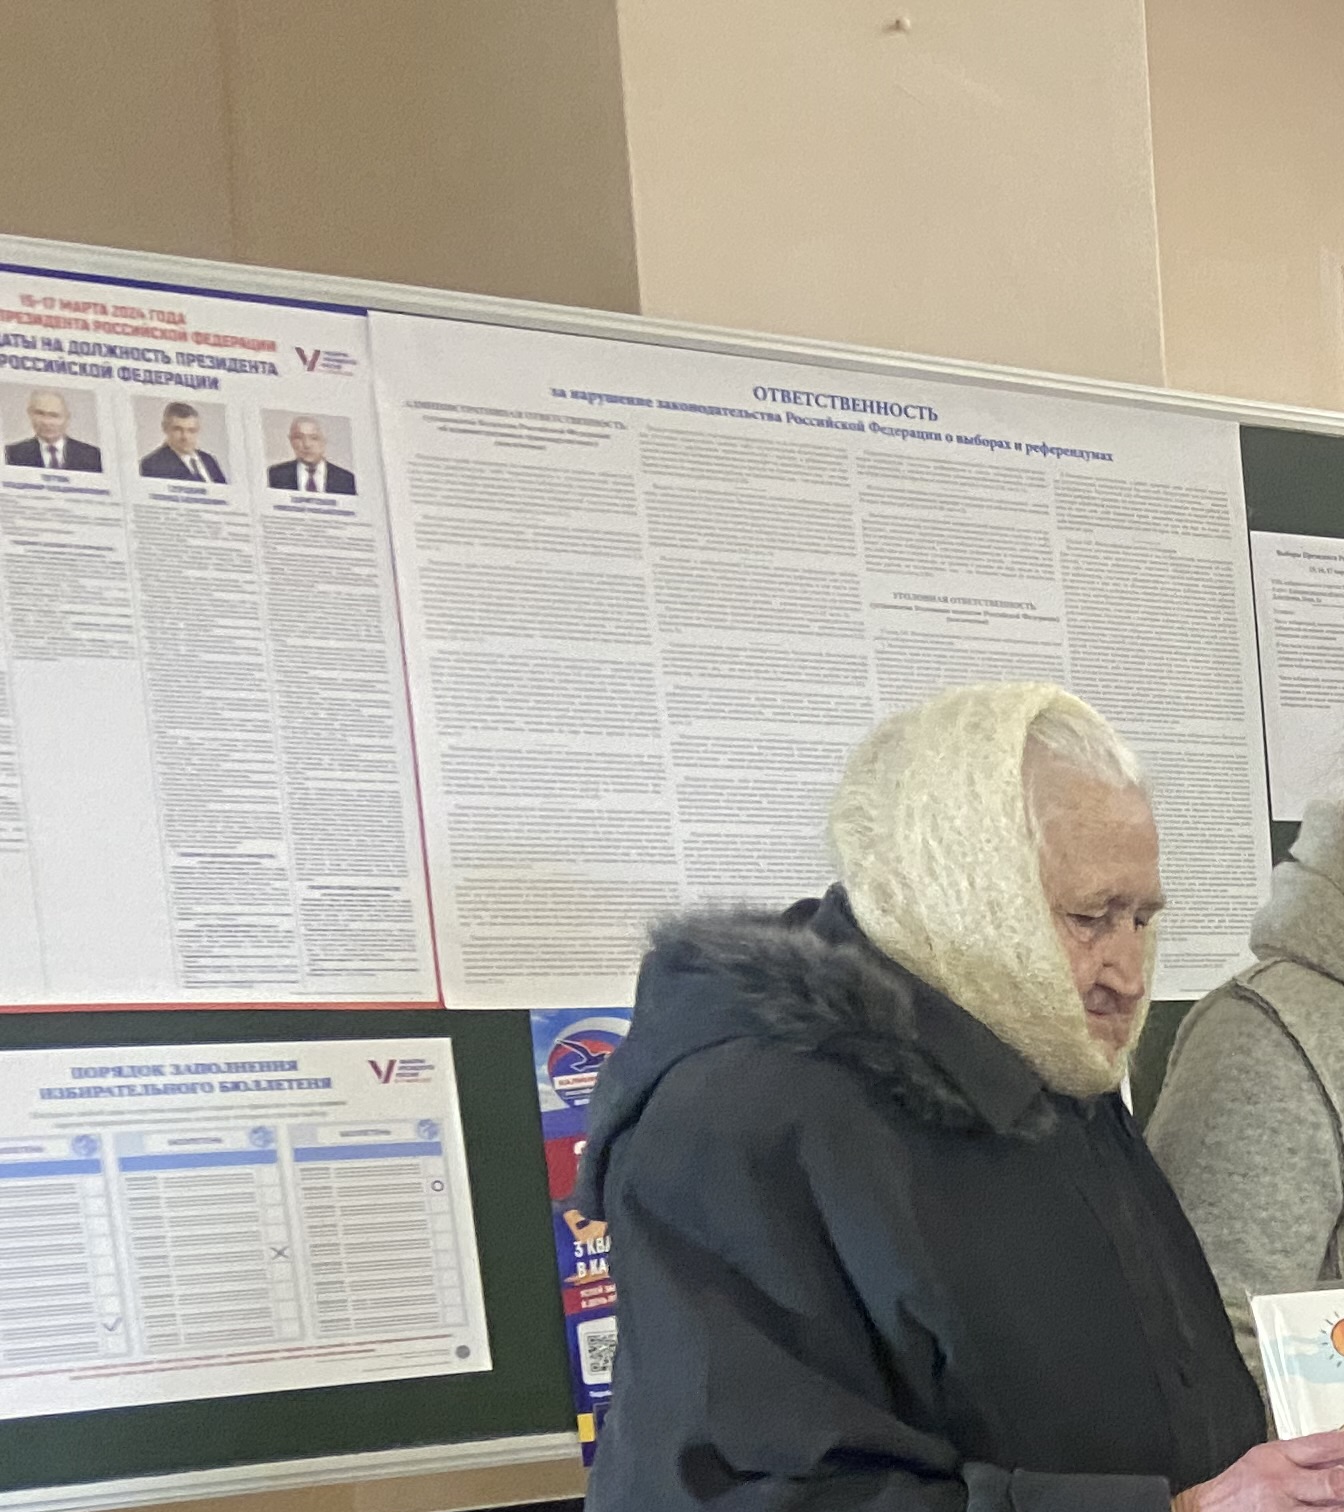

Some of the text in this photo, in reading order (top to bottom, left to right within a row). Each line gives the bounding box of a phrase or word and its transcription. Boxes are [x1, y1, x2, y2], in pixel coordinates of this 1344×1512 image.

[59, 298, 109, 317] МАРТА
[149, 308, 187, 326] ГОДА
[191, 331, 277, 351] ФЕДЕРАЦИИ
[41, 336, 65, 353] НА
[68, 340, 171, 365] ДОЛЖНОСТЬ
[175, 351, 279, 376] ПРЕЗИДЕНТА
[0, 353, 221, 390] РОССИЙСКОЙ ФЕДЕРАЦИИ
[753, 386, 939, 422] ОТВЕТСТВЕННОСТЬ
[570, 389, 652, 408] нарушение
[656, 399, 782, 423] законодательства
[786, 410, 866, 433] Российской
[869, 420, 942, 443] Федерации
[945, 433, 954, 443] о
[956, 434, 1011, 451] выборах
[1015, 442, 1022, 452] и
[1026, 440, 1114, 462] референдумах
[71, 1059, 298, 1080] ПОРЯДОК ЗАПОЛНЕНИЯ
[39, 1077, 332, 1100] ИЗБИРАТЕЛЬНОГО БЮЛЛЕТЕНЯ
[573, 1241, 584, 1258] 3
